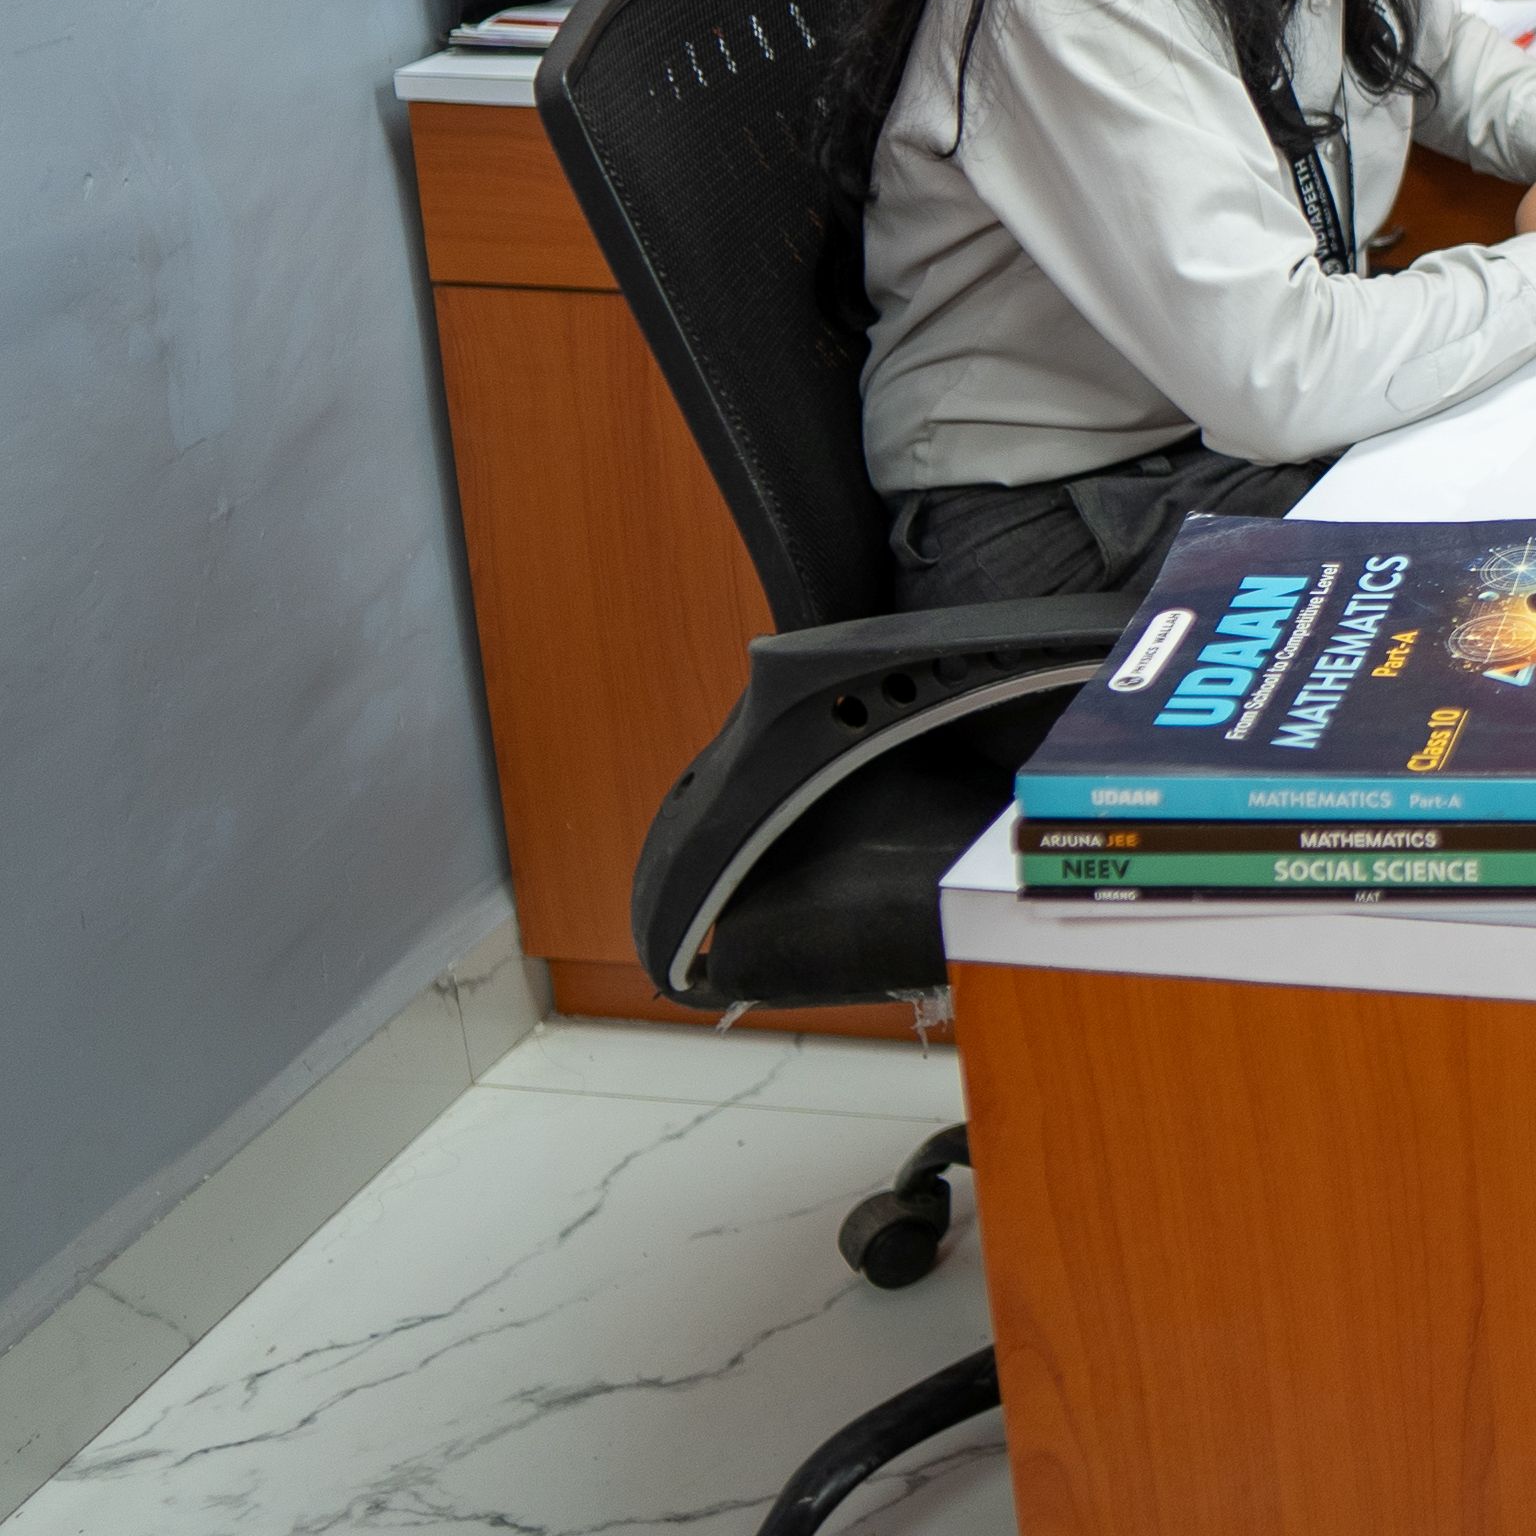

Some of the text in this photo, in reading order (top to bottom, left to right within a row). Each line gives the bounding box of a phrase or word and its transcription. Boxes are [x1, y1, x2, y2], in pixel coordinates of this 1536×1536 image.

[1131, 613, 1182, 675] PHYSICS WALLAH
[1153, 576, 1310, 726] UDAAN
[1224, 562, 1341, 740] From School to Competitive Level
[1270, 554, 1410, 750] MATHEMATICS
[1371, 629, 1420, 678] Part-A
[1406, 708, 1462, 772] Class 10
[1091, 788, 1161, 806] UDAAN
[1248, 788, 1394, 809] MATHEMATICS
[1409, 792, 1462, 809] Part-A
[1039, 833, 1103, 848] ARJUNA
[1106, 833, 1139, 848] JEE
[1300, 830, 1438, 849] MATHEMATICS
[1062, 858, 1131, 880] NEEV
[1274, 858, 1368, 882] SOCIAL
[1372, 859, 1479, 883] SCIENCE
